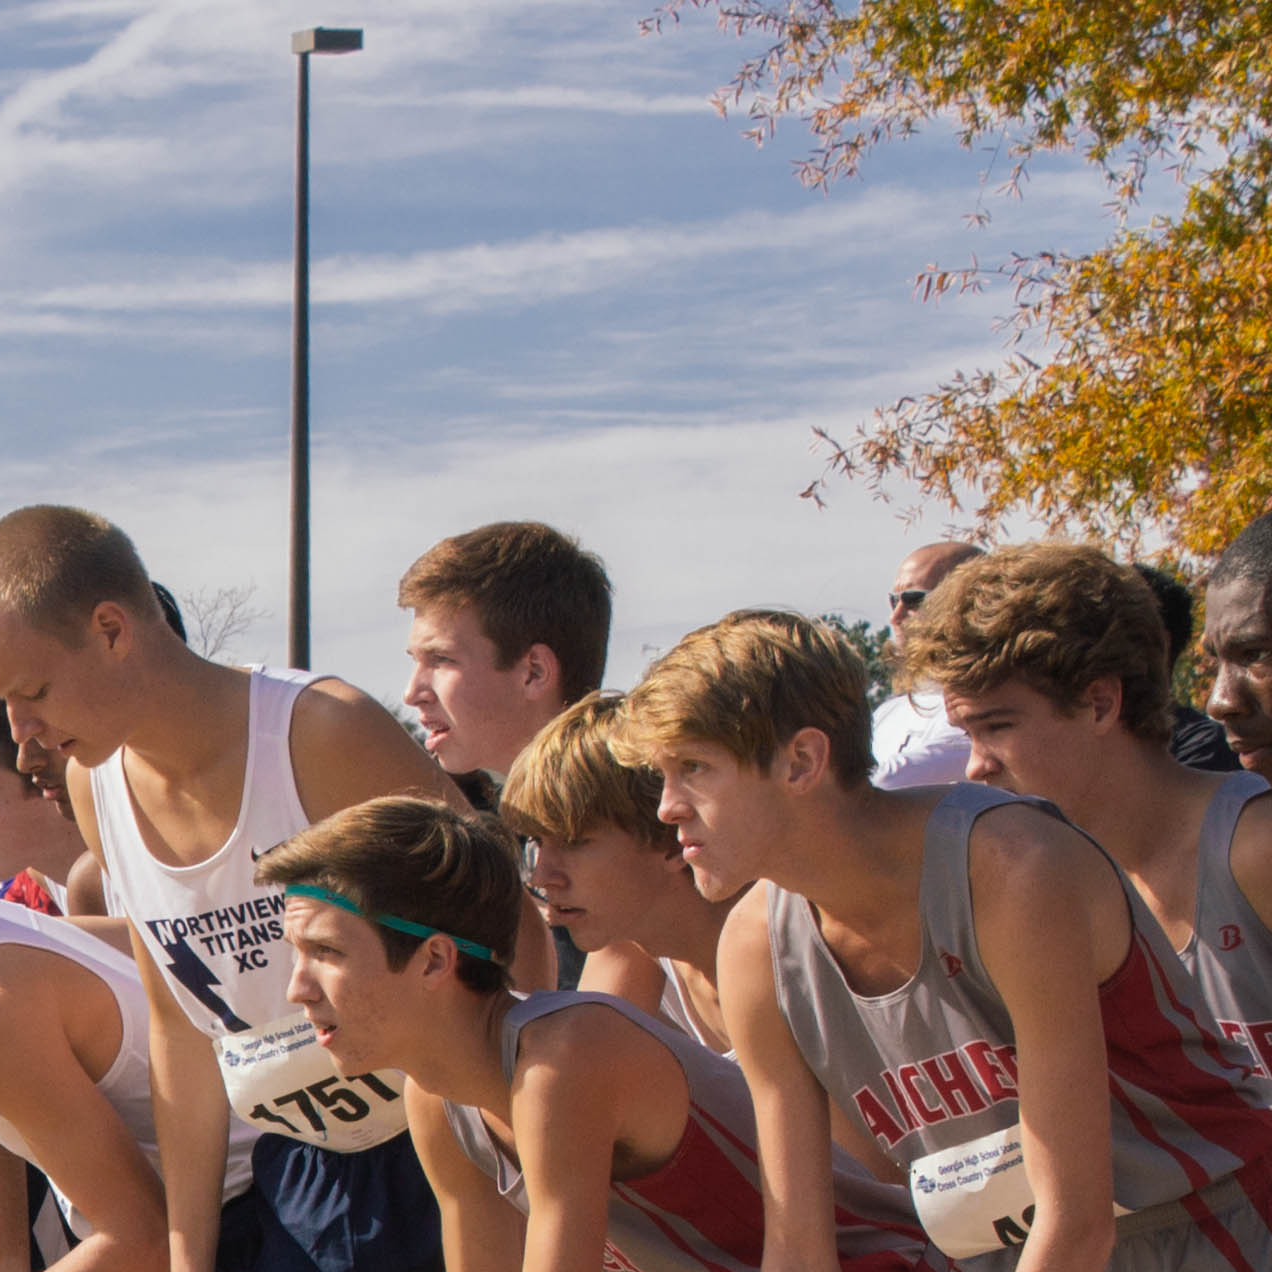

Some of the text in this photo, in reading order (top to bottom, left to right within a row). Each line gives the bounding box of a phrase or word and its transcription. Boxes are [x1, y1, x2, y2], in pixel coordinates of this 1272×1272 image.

[199, 920, 284, 956] TITANS
[233, 949, 268, 974] XC
[249, 1072, 401, 1134] 1751
[938, 1160, 964, 1175] Georgia
[963, 1154, 979, 1167] High
[979, 1148, 1000, 1162] School
[937, 1180, 957, 1193] Cross
[957, 1172, 984, 1186] Country
